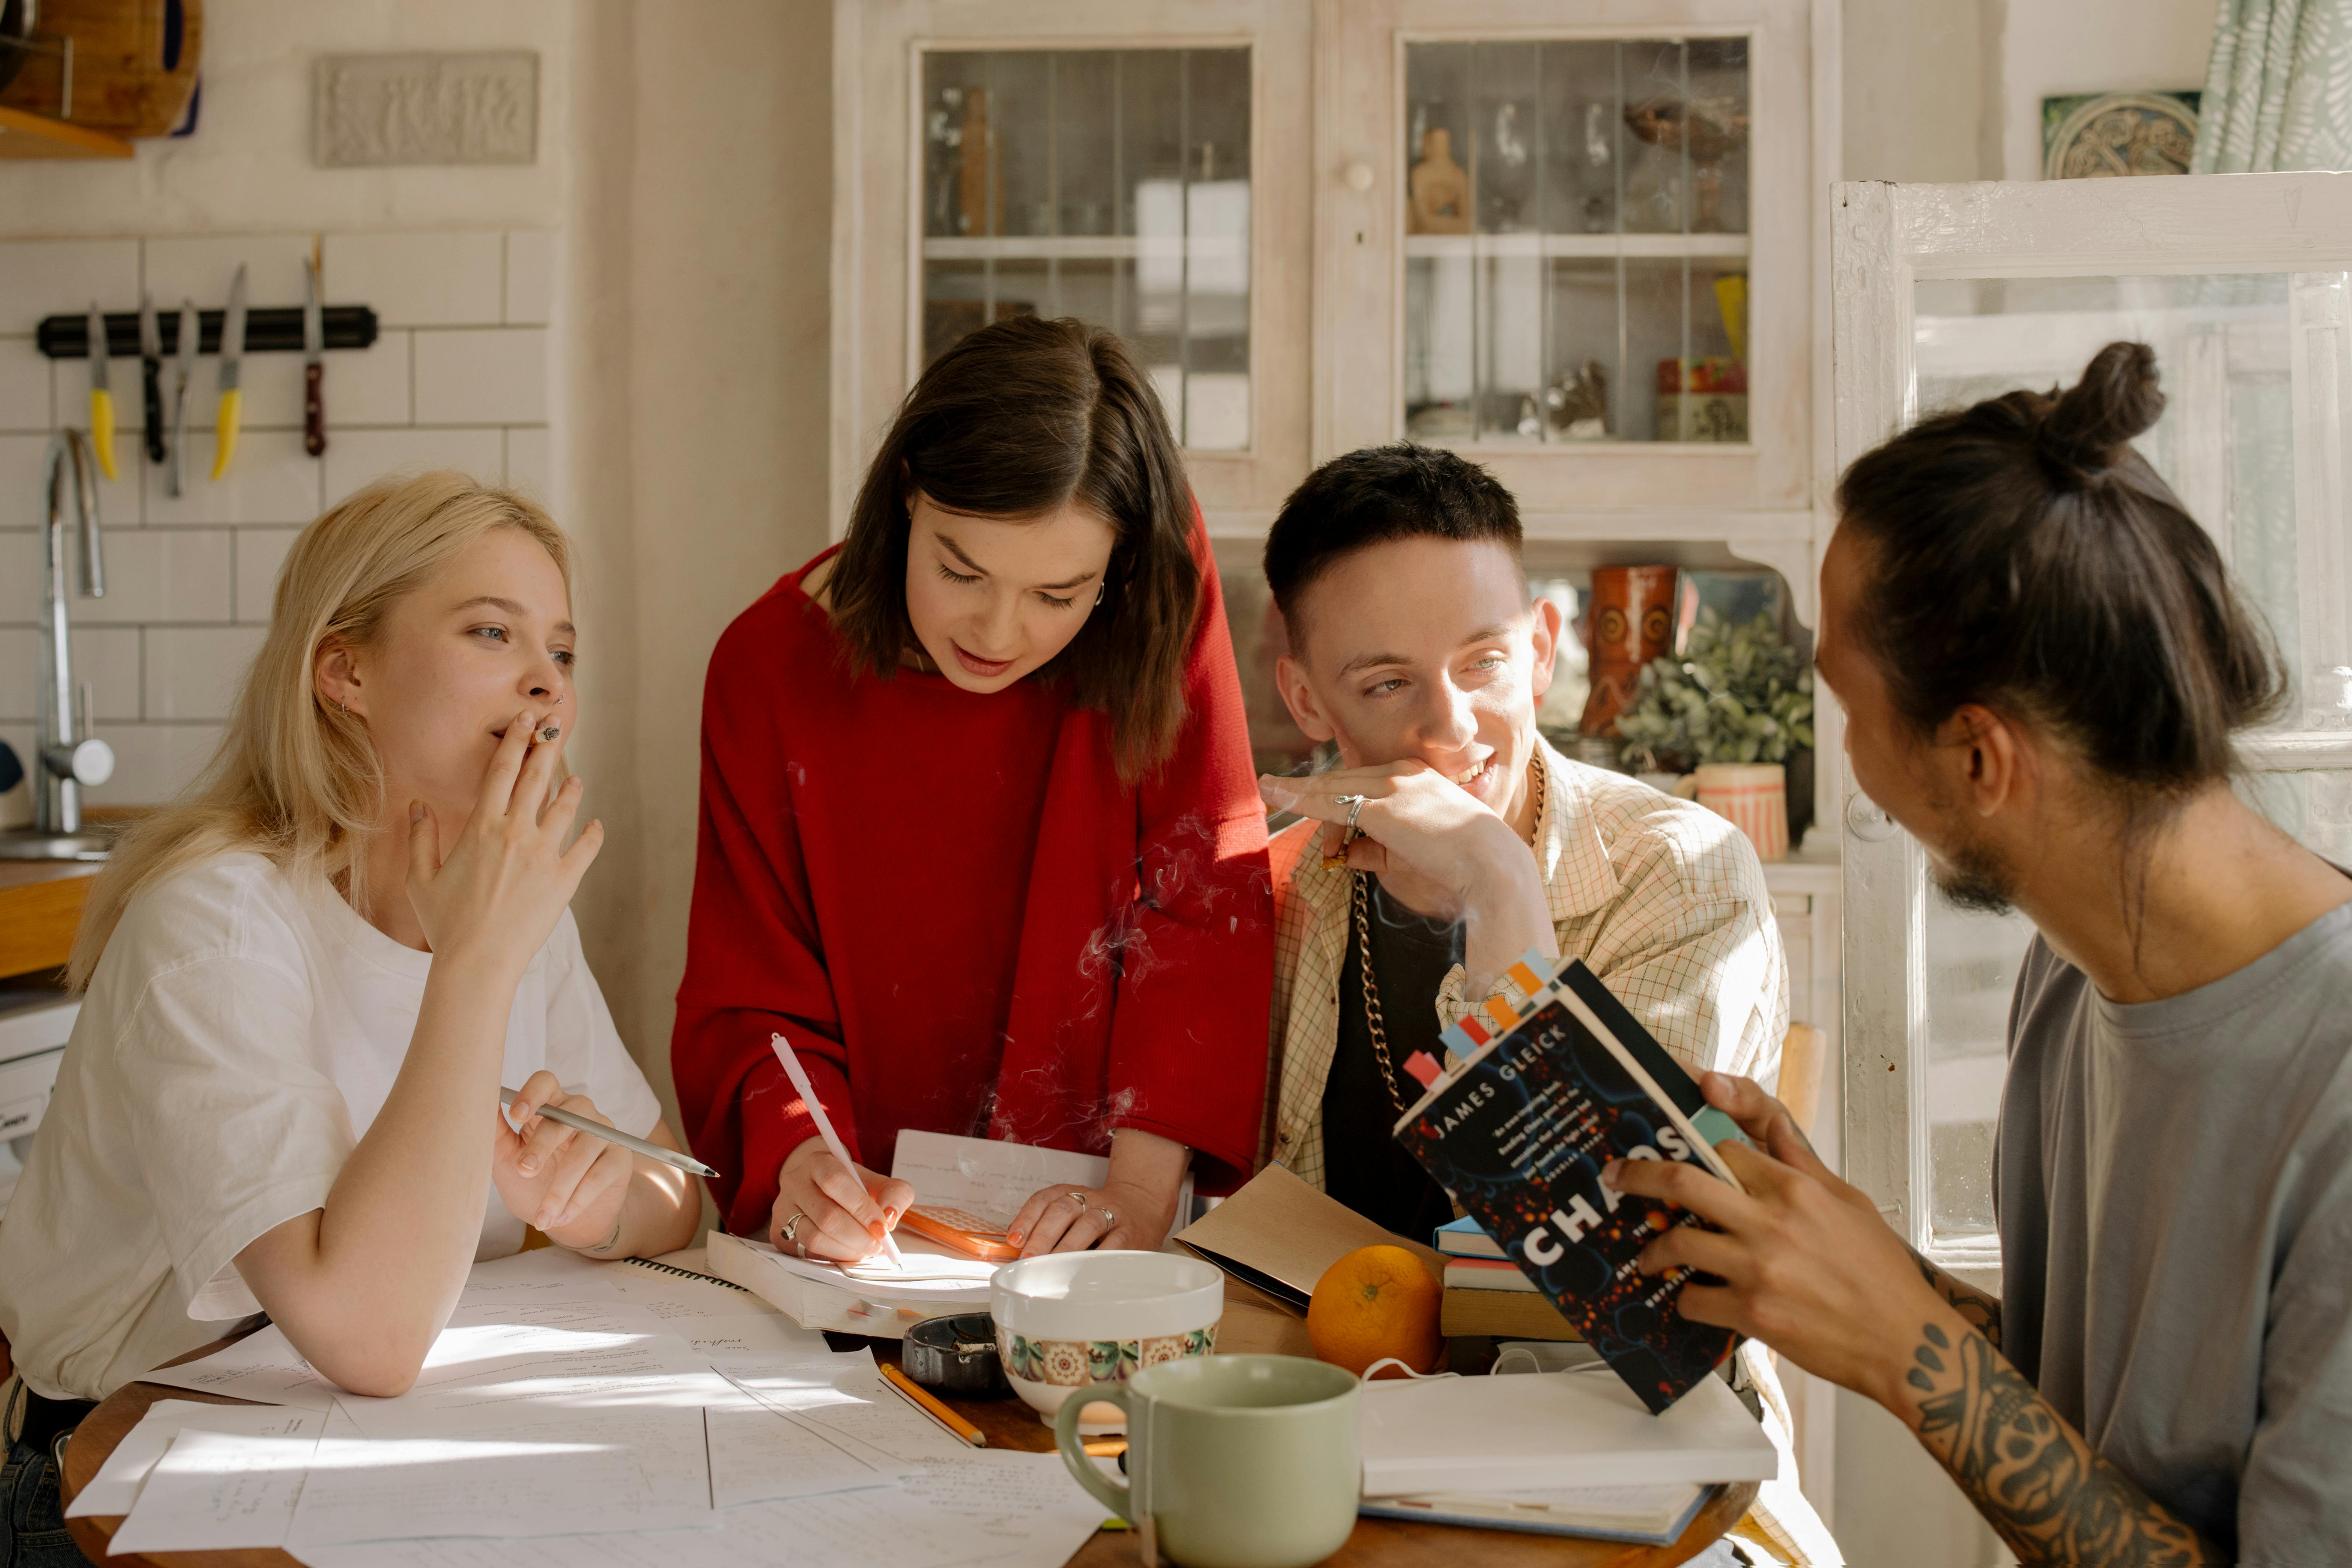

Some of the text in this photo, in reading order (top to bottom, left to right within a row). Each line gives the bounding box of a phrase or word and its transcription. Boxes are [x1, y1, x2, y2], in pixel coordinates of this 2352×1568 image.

[1434, 1024, 1567, 1140] JAMES GLEICK
[1498, 1132, 1527, 1156] Reading
[1524, 1117, 1544, 1134] Chaos
[1511, 1141, 1541, 1169] sensation
[1539, 1130, 1553, 1144] that
[1552, 1109, 1580, 1133] someone
[1534, 1149, 1556, 1168] found
[1554, 1141, 1566, 1153] the
[1544, 1132, 1604, 1183] DOUGLAS ADAMS
